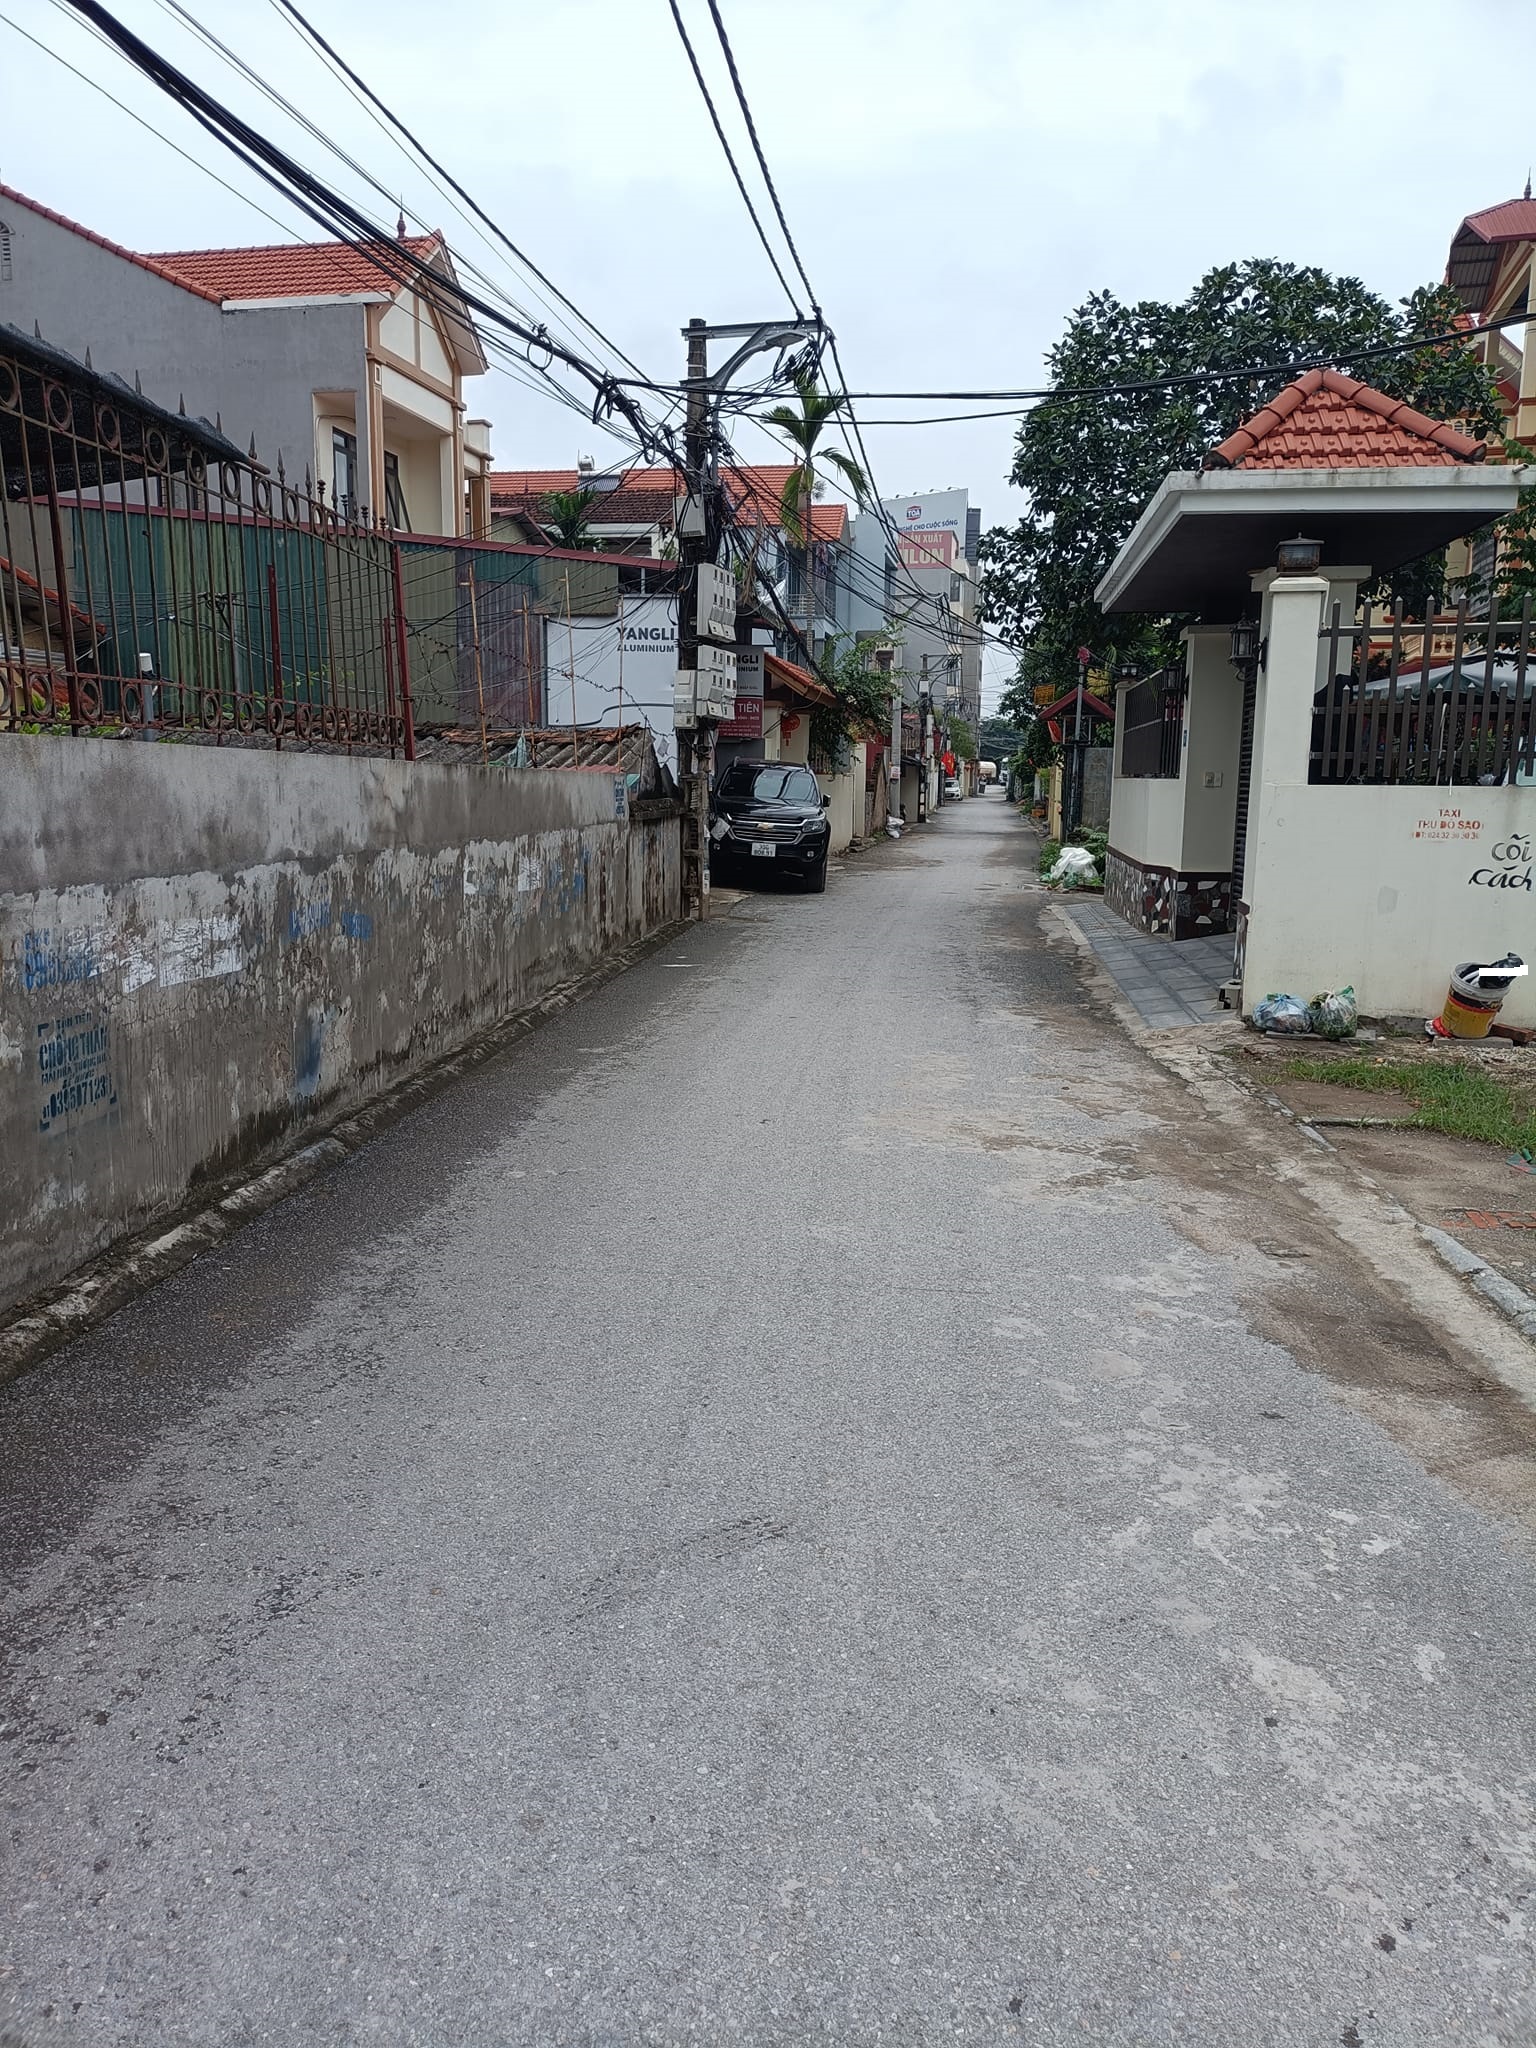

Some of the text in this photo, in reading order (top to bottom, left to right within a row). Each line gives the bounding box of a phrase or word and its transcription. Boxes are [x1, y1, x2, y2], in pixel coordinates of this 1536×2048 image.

[914, 522, 926, 530] CHO
[616, 627, 675, 640] YANGLI
[617, 644, 675, 652] ALUMINIUM
[1439, 808, 1461, 818] TAXI
